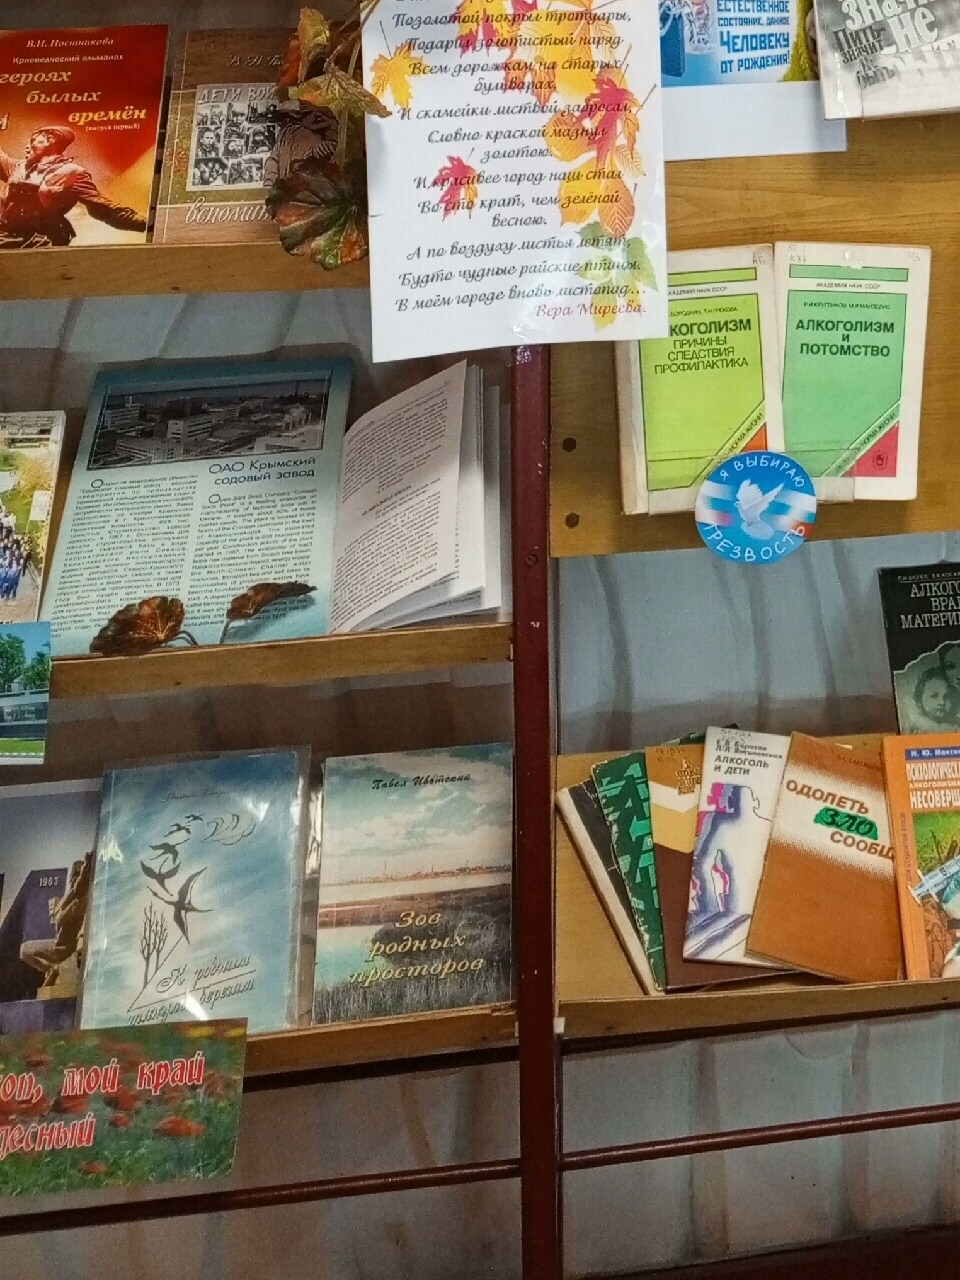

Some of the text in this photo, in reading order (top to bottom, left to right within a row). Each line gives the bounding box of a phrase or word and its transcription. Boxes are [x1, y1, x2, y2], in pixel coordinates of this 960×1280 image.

[717, 0, 790, 13] ЕСТЕСТВЕННОЕ
[889, 7, 938, 53] не
[720, 31, 790, 54] ЧЕЛОВЕКУ
[409, 62, 450, 75] Всем
[720, 53, 790, 74] ОТ РОЖДЕНИЯ!
[26, 90, 101, 104] былых
[198, 88, 242, 104] ДЕТИ
[68, 106, 146, 126] времён
[416, 104, 489, 119] скамейки
[486, 126, 547, 139] краской
[534, 303, 573, 318] Вера
[796, 319, 895, 334] АЛКОГОЛИЗМ
[673, 336, 727, 348] ПРИЧИНЫ
[800, 344, 890, 357] ПОТОМСТВО
[668, 347, 734, 362] СЛЕДСТВИЯ
[654, 358, 748, 375] ПРОФИЛАКТИКА
[208, 455, 317, 476] ОАО Крымский
[734, 456, 805, 488] ВЫБИРАЮ
[214, 468, 315, 486] содовый завод
[704, 523, 805, 562] ТРЕЗВОСТЬ
[714, 754, 769, 769] АЛКОГОЛЬ
[714, 765, 751, 777] И ДЕТИ
[786, 779, 869, 815] ОДОЛЕТЬ
[822, 807, 875, 836] ЗЛО
[395, 911, 442, 928] Зов
[365, 934, 466, 962] родных
[350, 958, 484, 988] просторов
[137, 1051, 205, 1095] край
